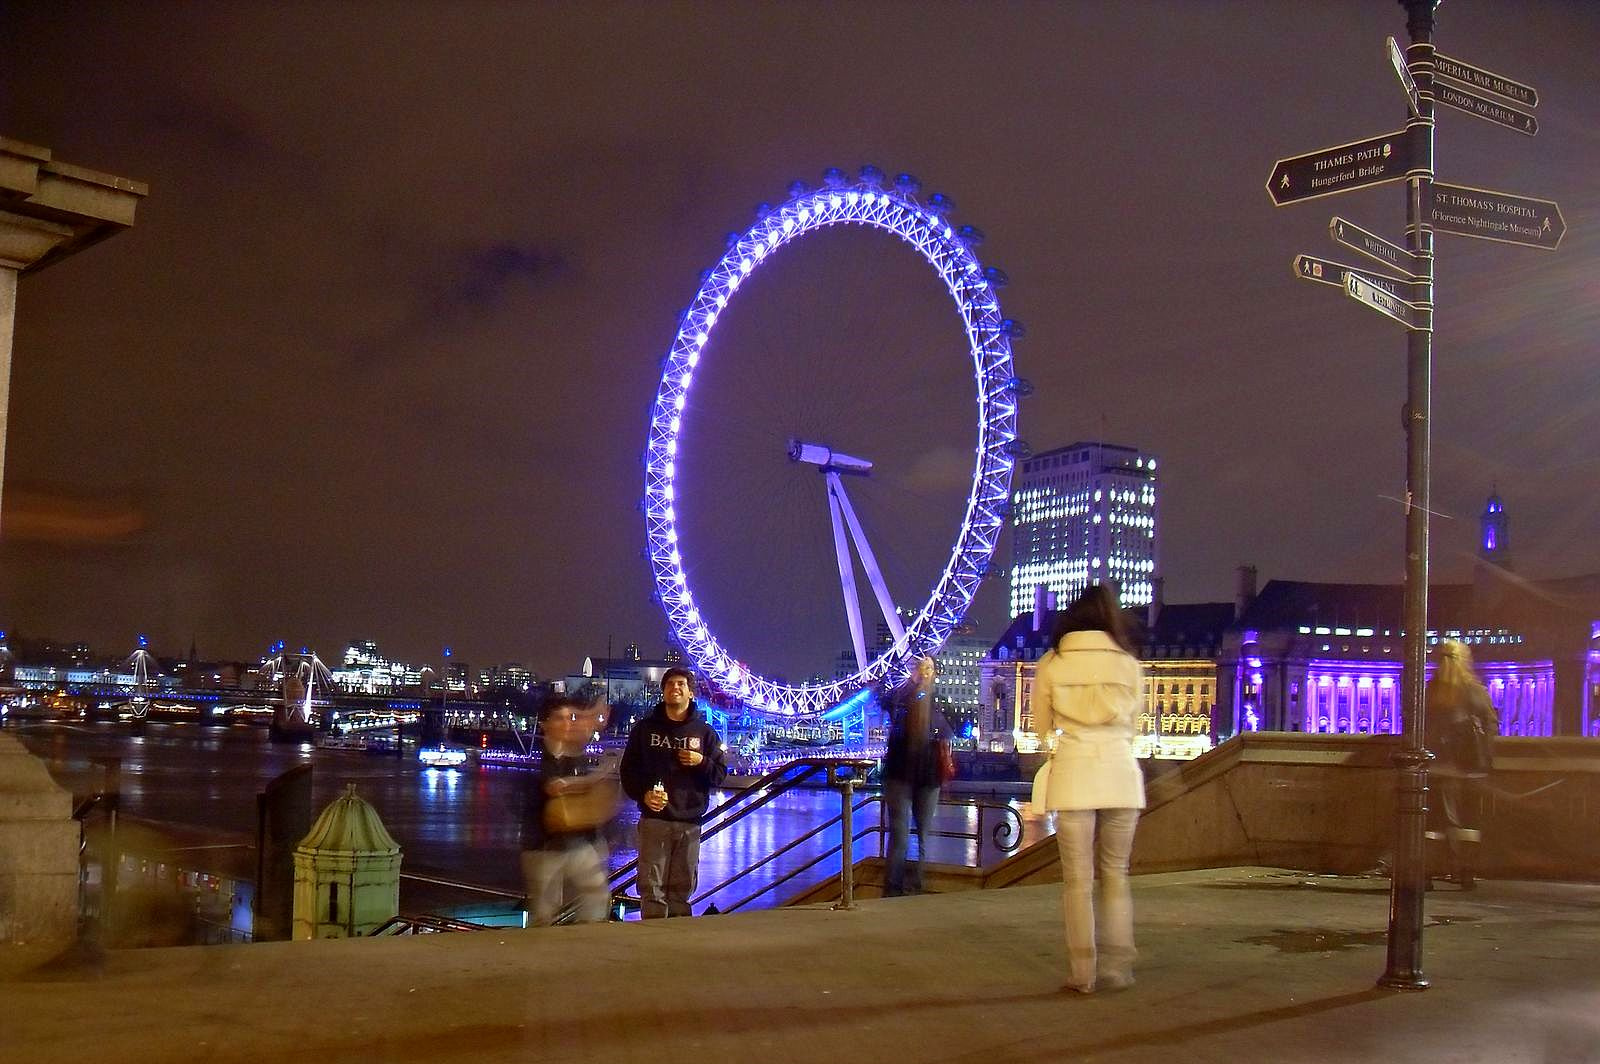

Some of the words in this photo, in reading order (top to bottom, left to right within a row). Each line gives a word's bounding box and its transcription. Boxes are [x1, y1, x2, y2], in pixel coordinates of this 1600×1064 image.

[1473, 73, 1491, 88] WAR
[1493, 80, 1528, 98] MUSEUM
[1442, 89, 1474, 108] LONDON
[1475, 102, 1515, 124] AQUARIUM
[1313, 154, 1354, 172] THAMES
[1357, 147, 1381, 161] PATH
[1311, 170, 1355, 188] Hungerford
[1358, 164, 1385, 179] Bridge
[1497, 203, 1537, 218] HOSPITAL
[1431, 209, 1467, 225] (Florence
[1467, 216, 1509, 232] Nightingale
[1509, 223, 1542, 238] Museum)
[1363, 238, 1398, 262] WHITEHALL
[1489, 635, 1522, 644] HALL
